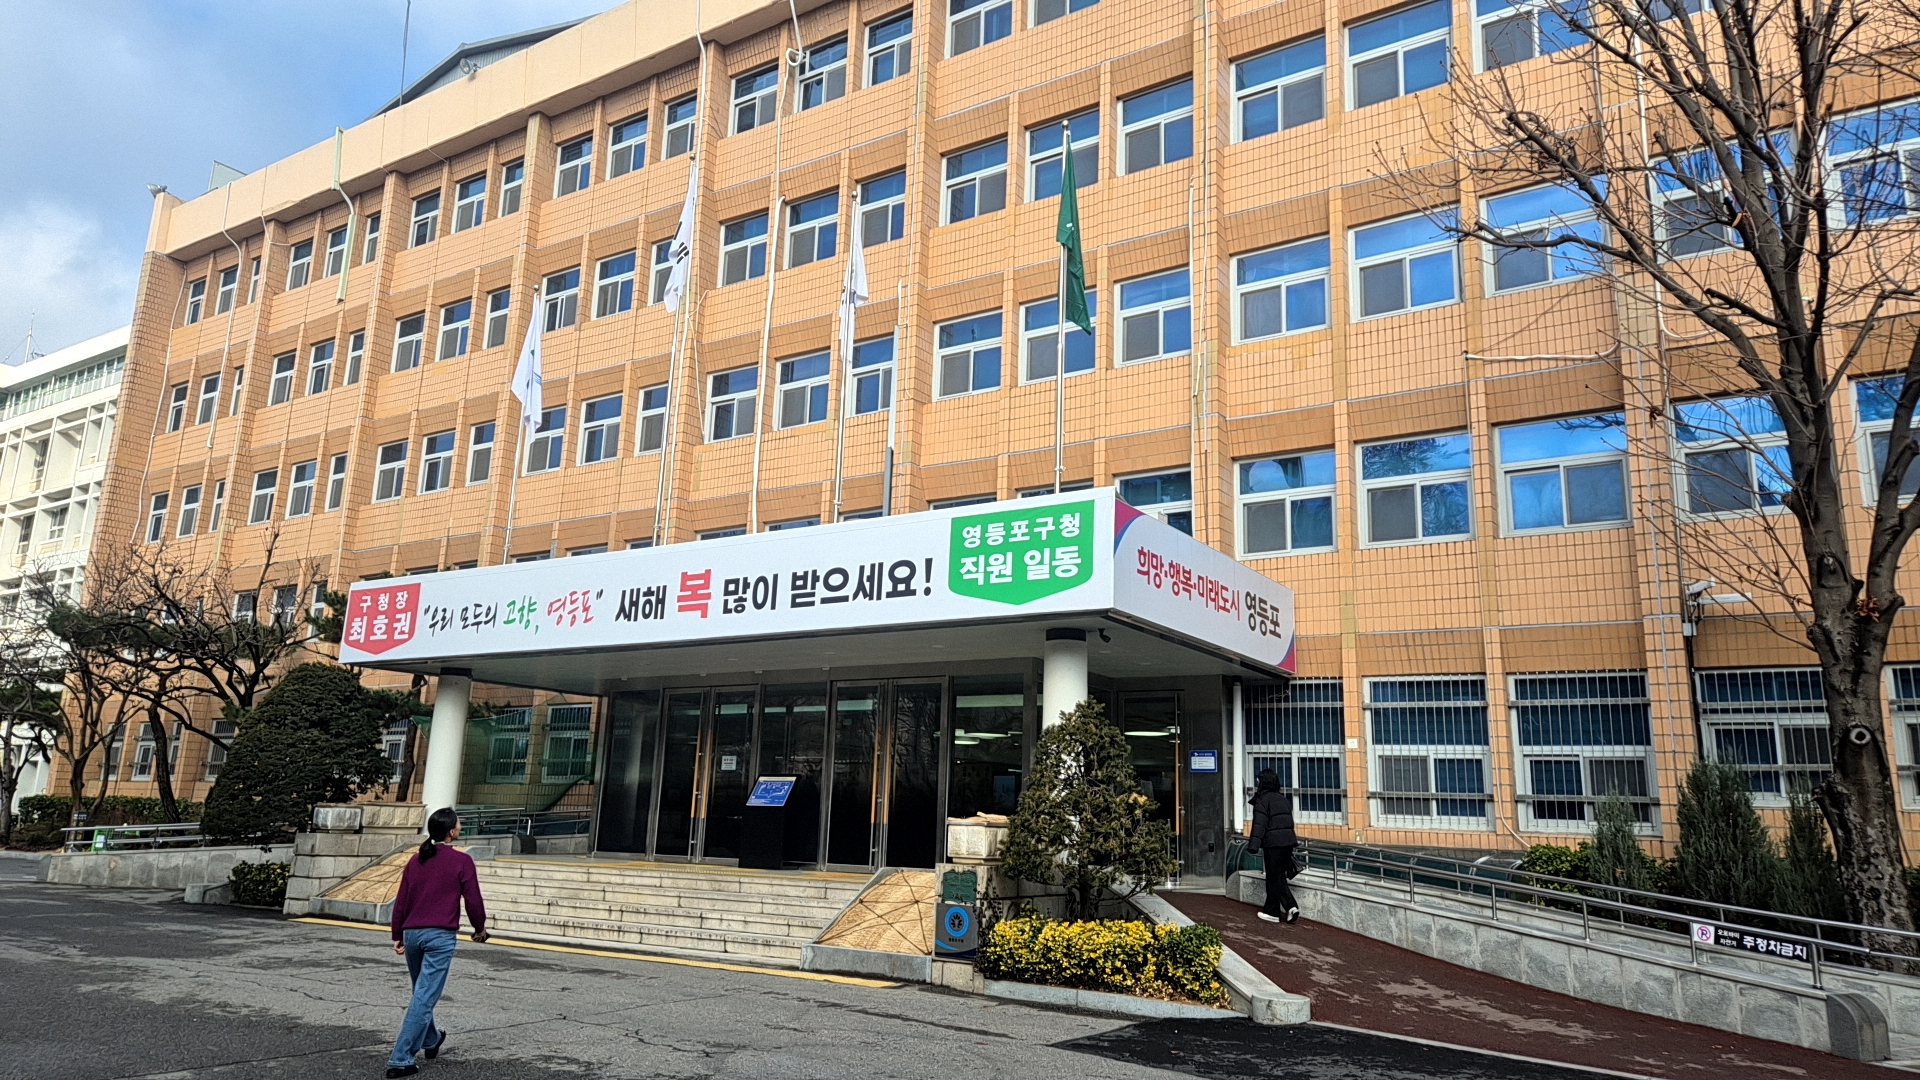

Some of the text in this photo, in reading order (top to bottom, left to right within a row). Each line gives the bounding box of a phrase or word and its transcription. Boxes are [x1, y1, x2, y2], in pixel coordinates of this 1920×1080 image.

[961, 512, 1081, 549] 영등포구청
[959, 545, 1082, 585] 직원 일동
[459, 601, 498, 634] 모두의
[503, 594, 540, 635] 고향,
[547, 588, 604, 628] 영등포"
[614, 584, 668, 623] 새해
[676, 568, 712, 619] 복
[722, 573, 779, 615] 많이
[790, 557, 934, 609] 받으세요!
[1244, 589, 1282, 639] 영등포
[348, 611, 412, 643] 최호권
[1742, 935, 1807, 960] 주정차금지
